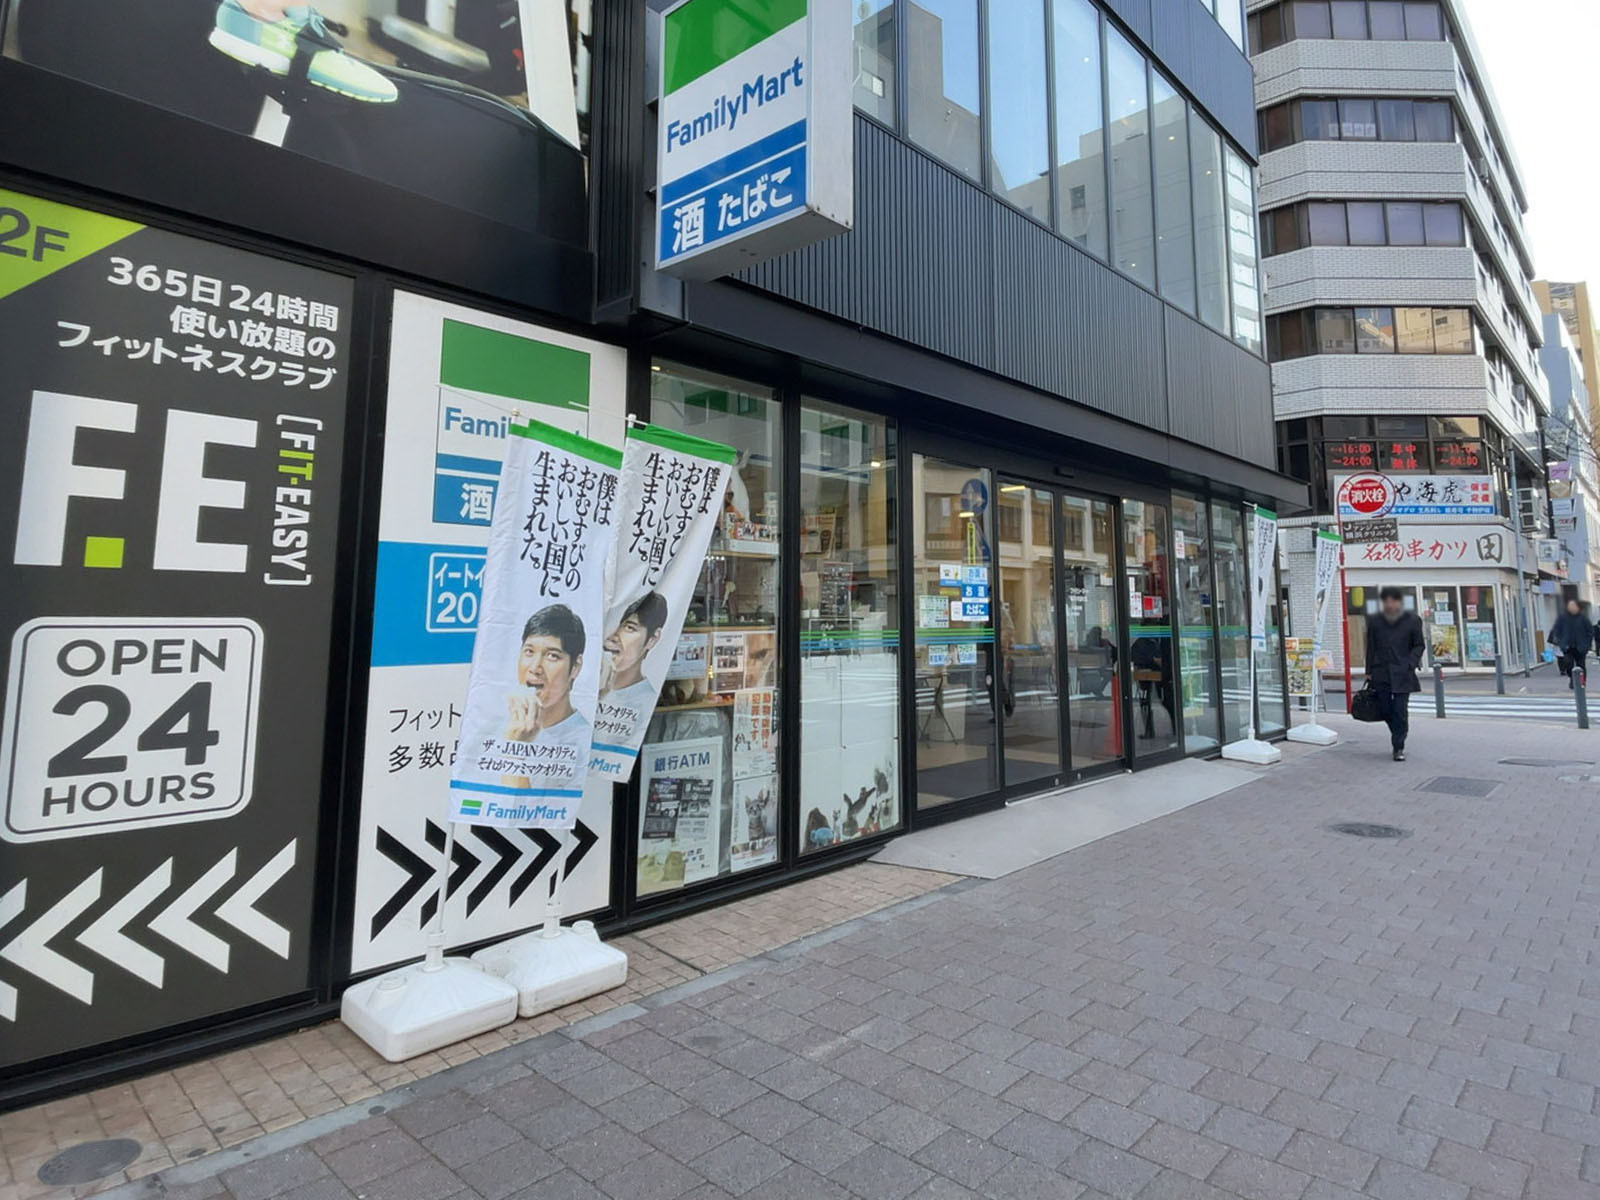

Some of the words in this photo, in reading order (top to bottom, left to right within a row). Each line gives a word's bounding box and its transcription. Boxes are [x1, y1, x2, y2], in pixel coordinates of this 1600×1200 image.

[667, 56, 803, 153] FamilyMart
[0, 207, 70, 262] 2F
[672, 198, 705, 253] 酒
[718, 167, 793, 231] たばこ
[107, 257, 339, 332] 365日24時間
[57, 320, 337, 390] フィットネスクラブ
[170, 304, 336, 361] 使い放題の
[460, 482, 494, 521] 酒
[519, 450, 556, 570] 生まれた。
[593, 472, 619, 525] 僕は
[641, 457, 684, 587] おいしい国に
[1351, 487, 1385, 504] 消火栓
[539, 457, 578, 598] おいしい国に
[565, 465, 595, 592] おむすびの
[1362, 538, 1468, 562] 名物串カツ
[435, 592, 478, 623] 20
[966, 604, 985, 615] たばこ
[56, 638, 228, 677] OPEN
[47, 681, 220, 778] 24
[654, 752, 711, 773] 銀行ATM
[42, 771, 216, 818] HOURS
[486, 802, 567, 820] FamilyMart
